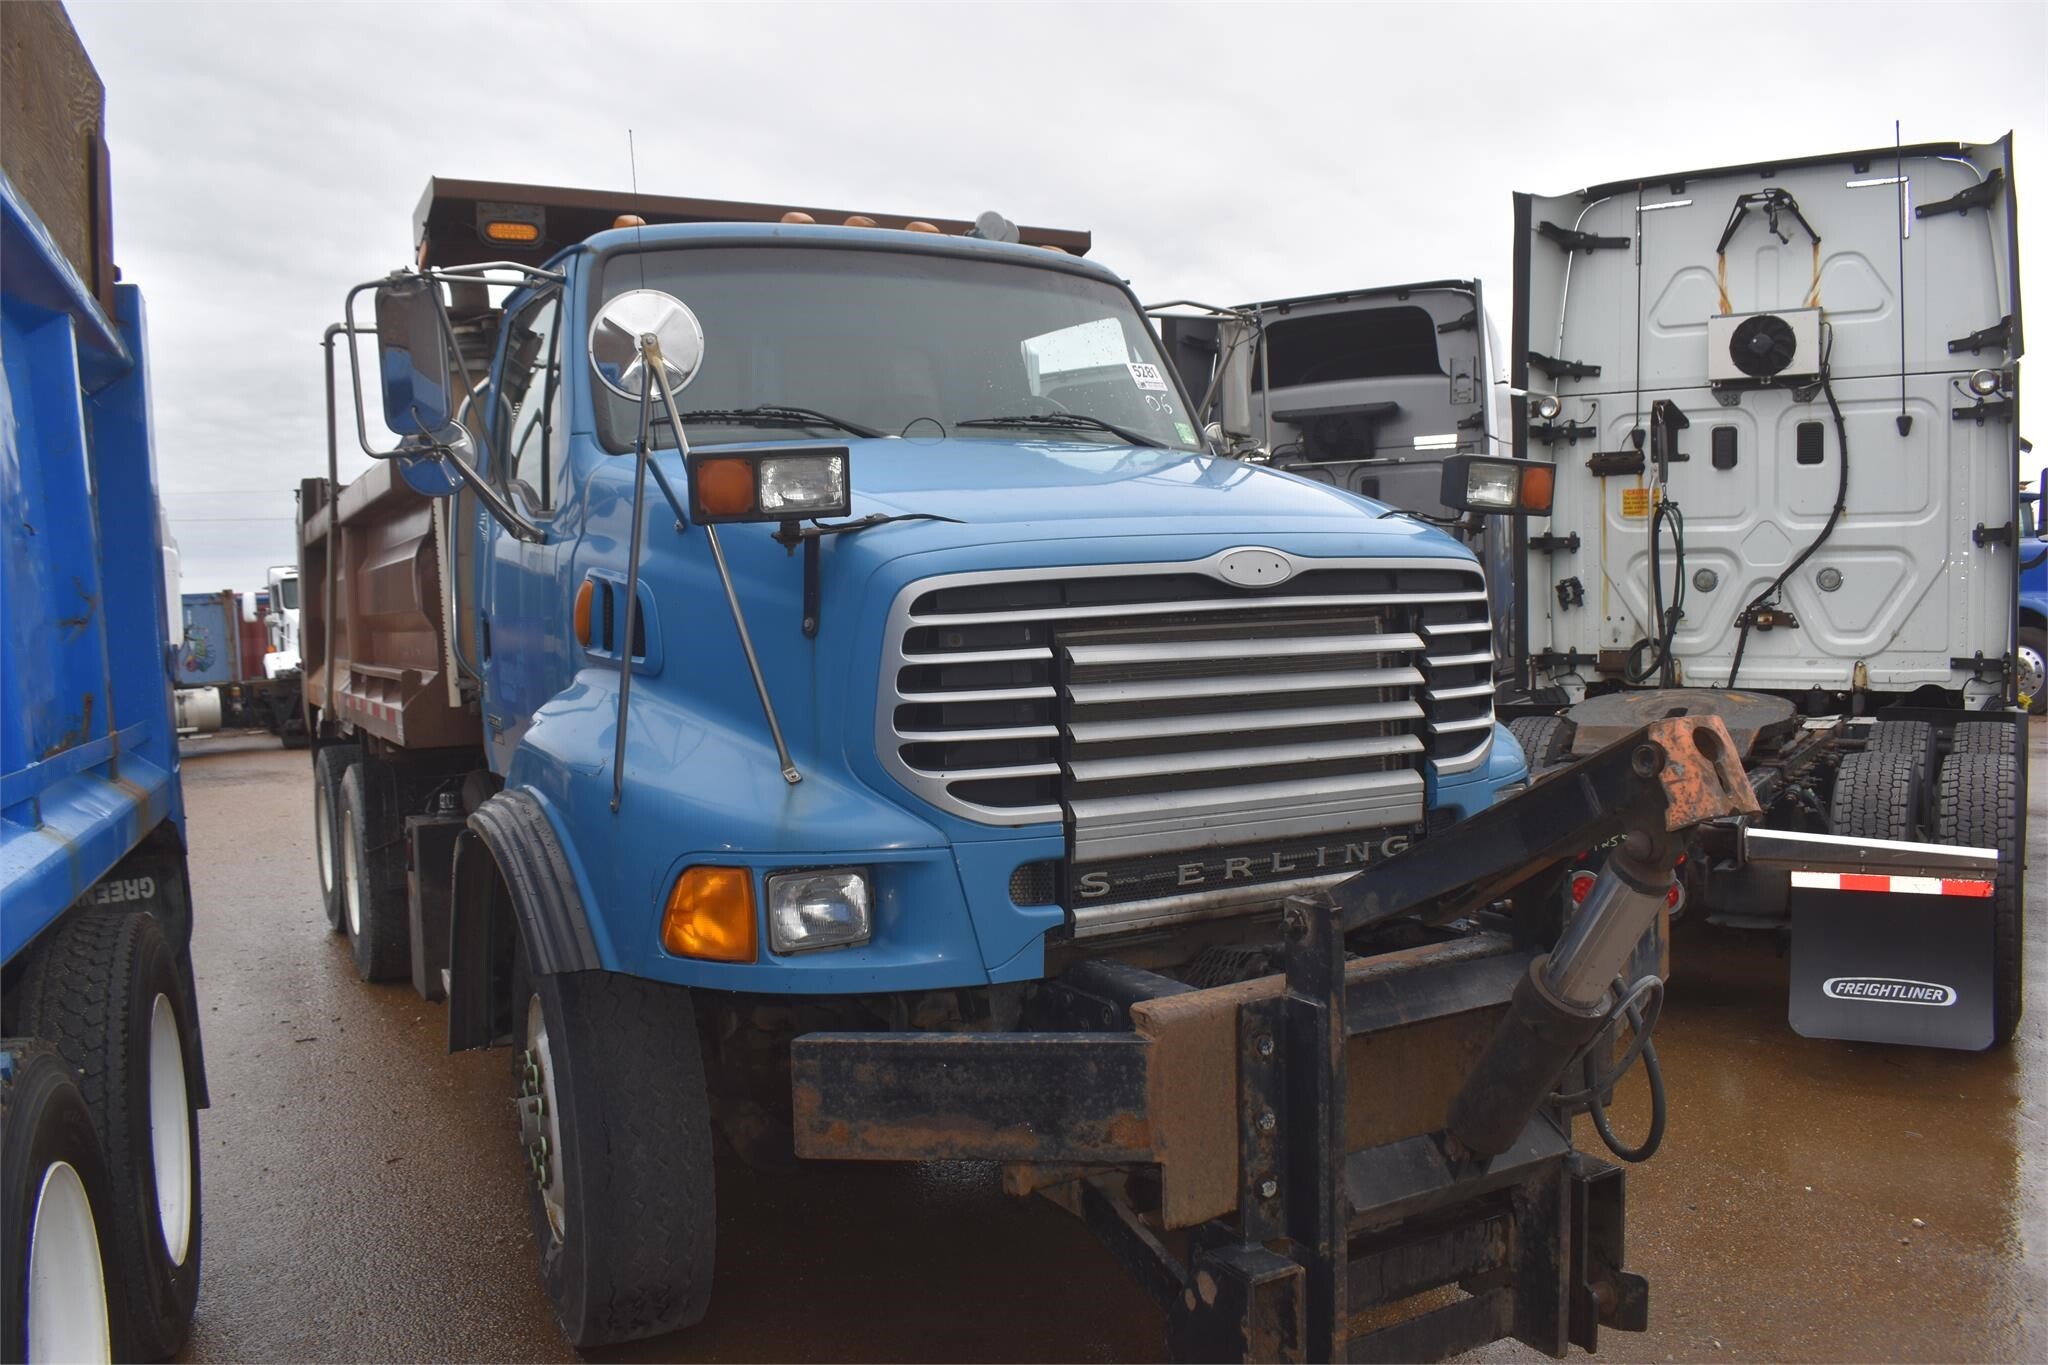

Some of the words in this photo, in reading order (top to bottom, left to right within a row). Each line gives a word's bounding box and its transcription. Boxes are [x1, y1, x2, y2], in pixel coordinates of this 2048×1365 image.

[1132, 365, 1158, 378] 5281
[1079, 835, 1409, 898] SERLING
[1835, 982, 1944, 1001] FREIGHTLINER
